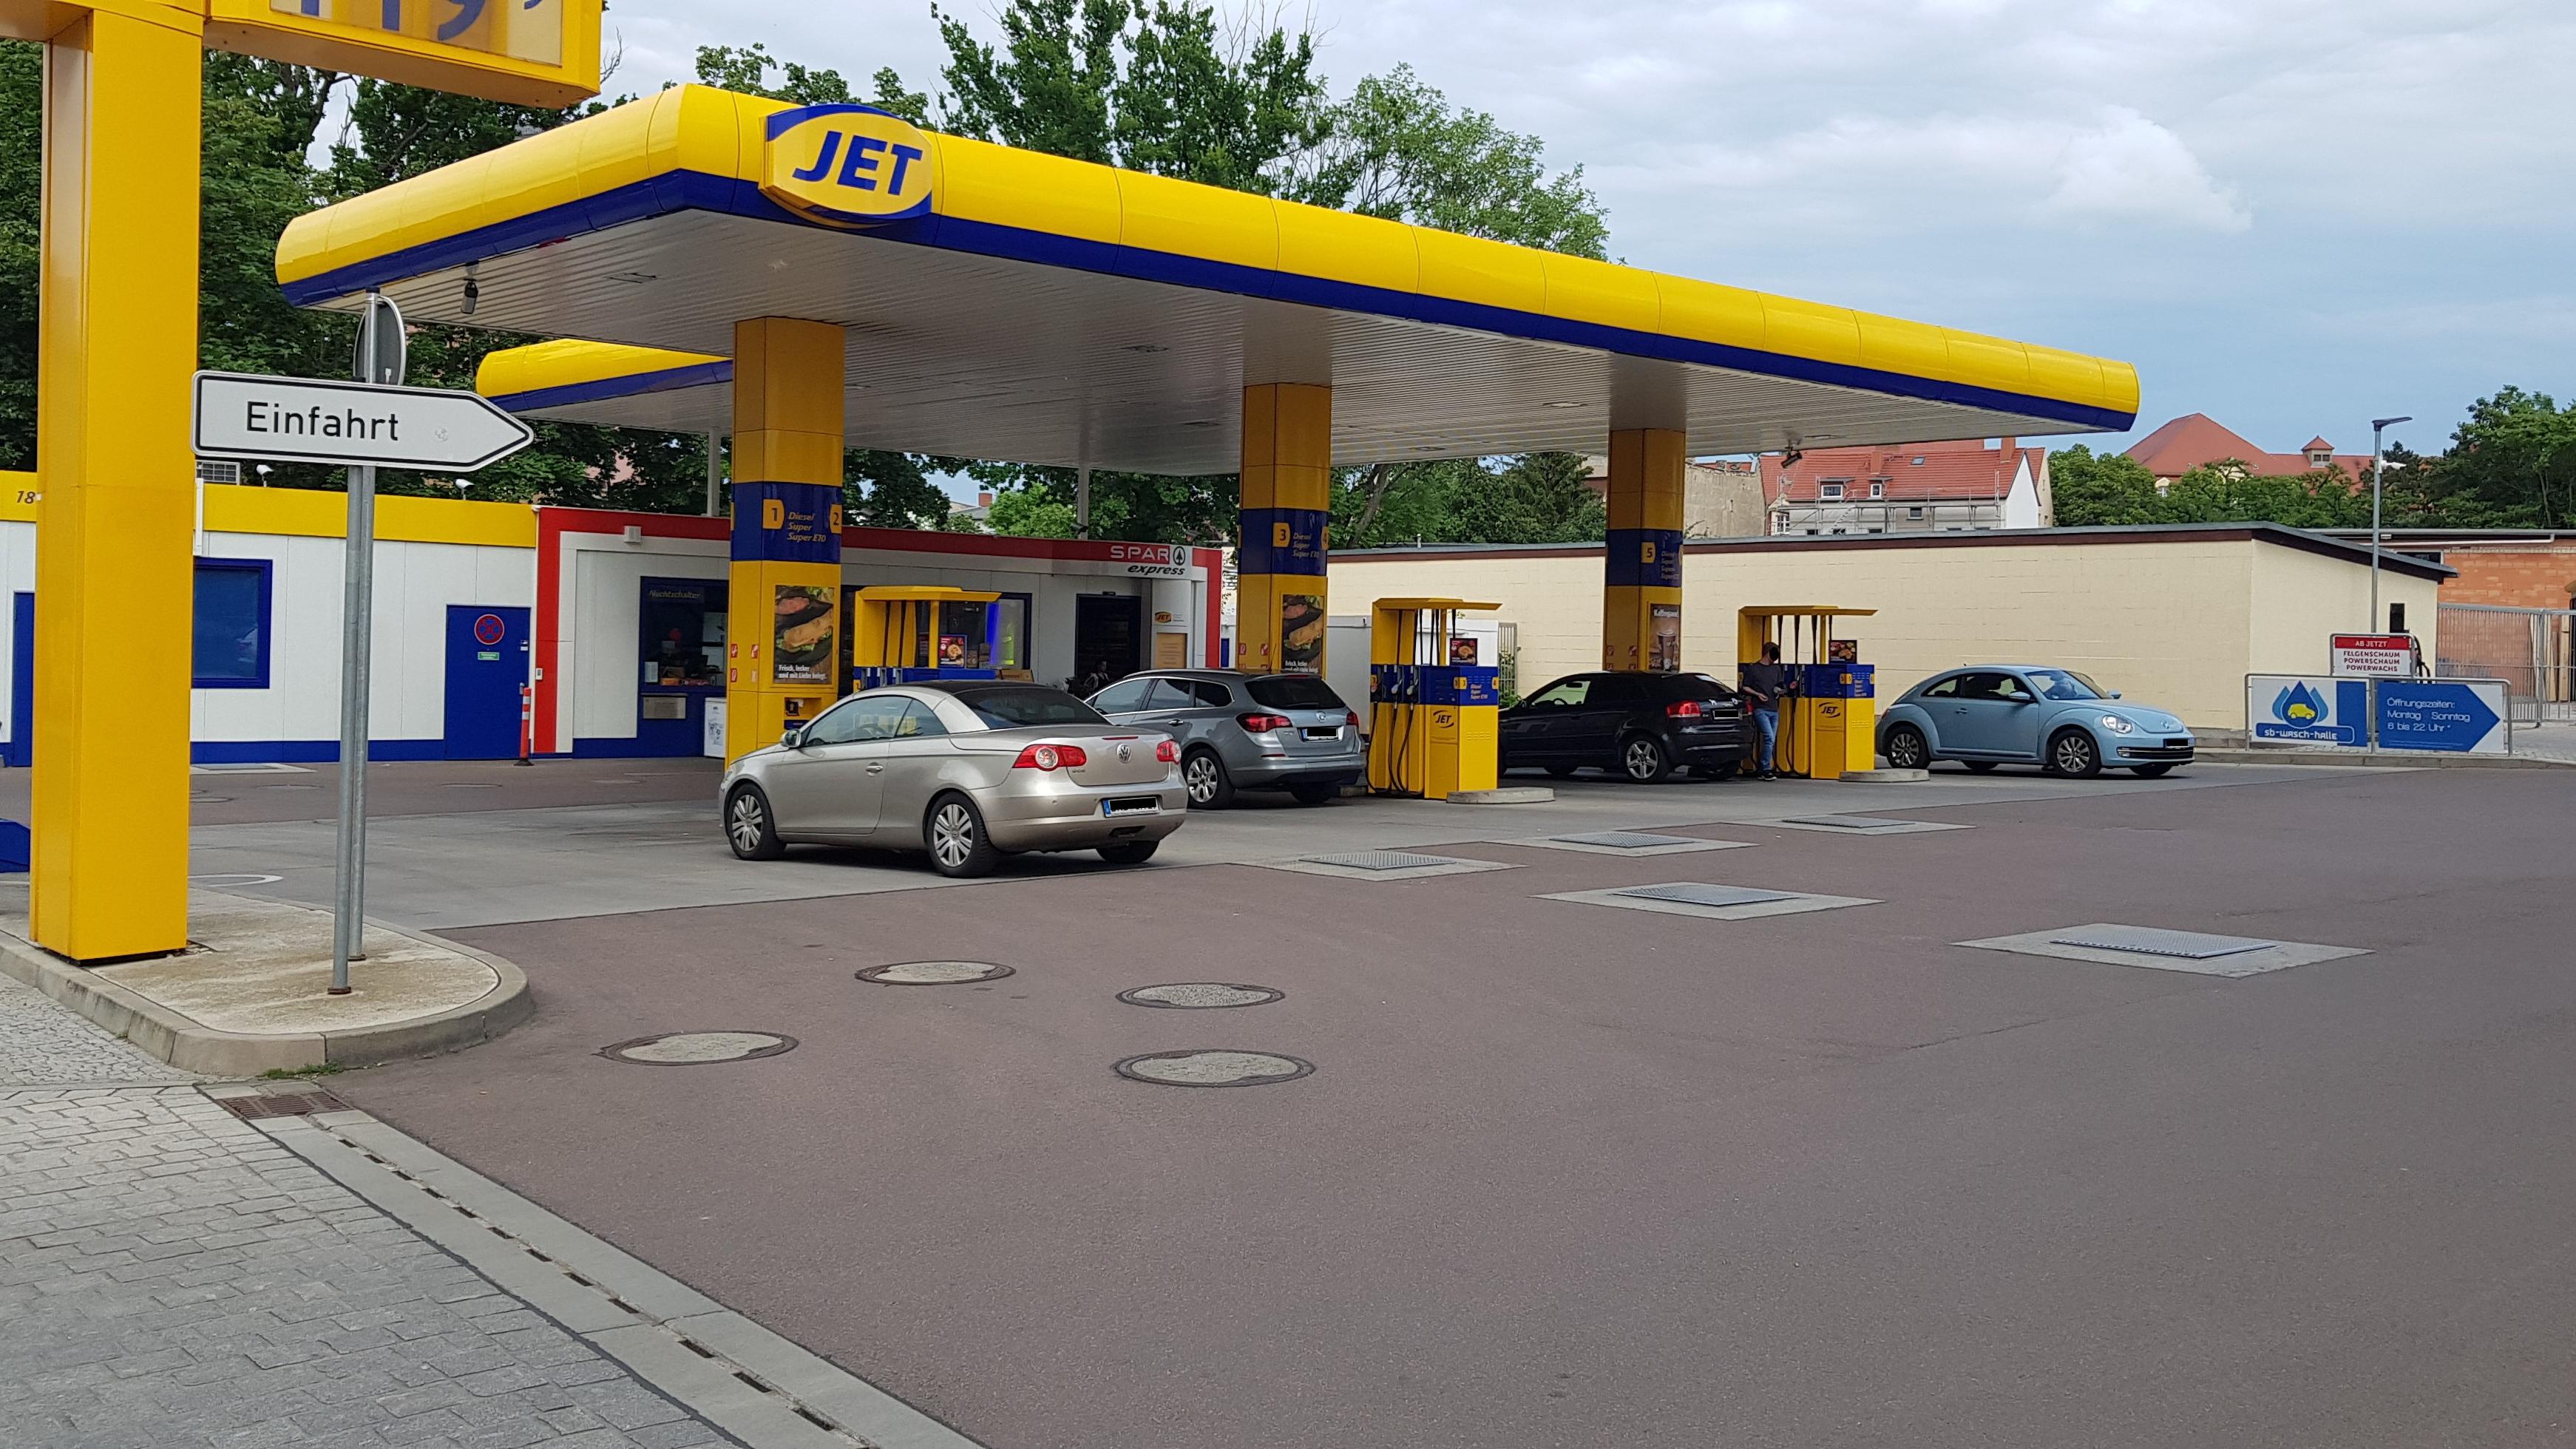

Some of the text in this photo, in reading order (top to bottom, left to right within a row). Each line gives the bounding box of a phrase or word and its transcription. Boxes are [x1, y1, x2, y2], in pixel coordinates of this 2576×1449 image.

[792, 130, 923, 196] JET
[246, 401, 399, 441] Einfahrt
[772, 508, 777, 521] 1
[788, 512, 815, 520] Diesel
[833, 512, 840, 526] 2
[787, 522, 812, 532] Super
[787, 532, 812, 543] Super
[1279, 529, 1286, 540] 3
[1110, 545, 1169, 562] SPAR
[1646, 547, 1653, 558] 5
[1128, 565, 1186, 576] express
[2387, 697, 2455, 709] Öffnungszeiten:
[1821, 706, 1839, 714] JET
[1435, 715, 1452, 724] JET
[2387, 710, 2471, 723] Montag Sonntag
[2396, 722, 2410, 730] bis
[2413, 723, 2426, 732] 22
[2428, 723, 2446, 732] Uhr
